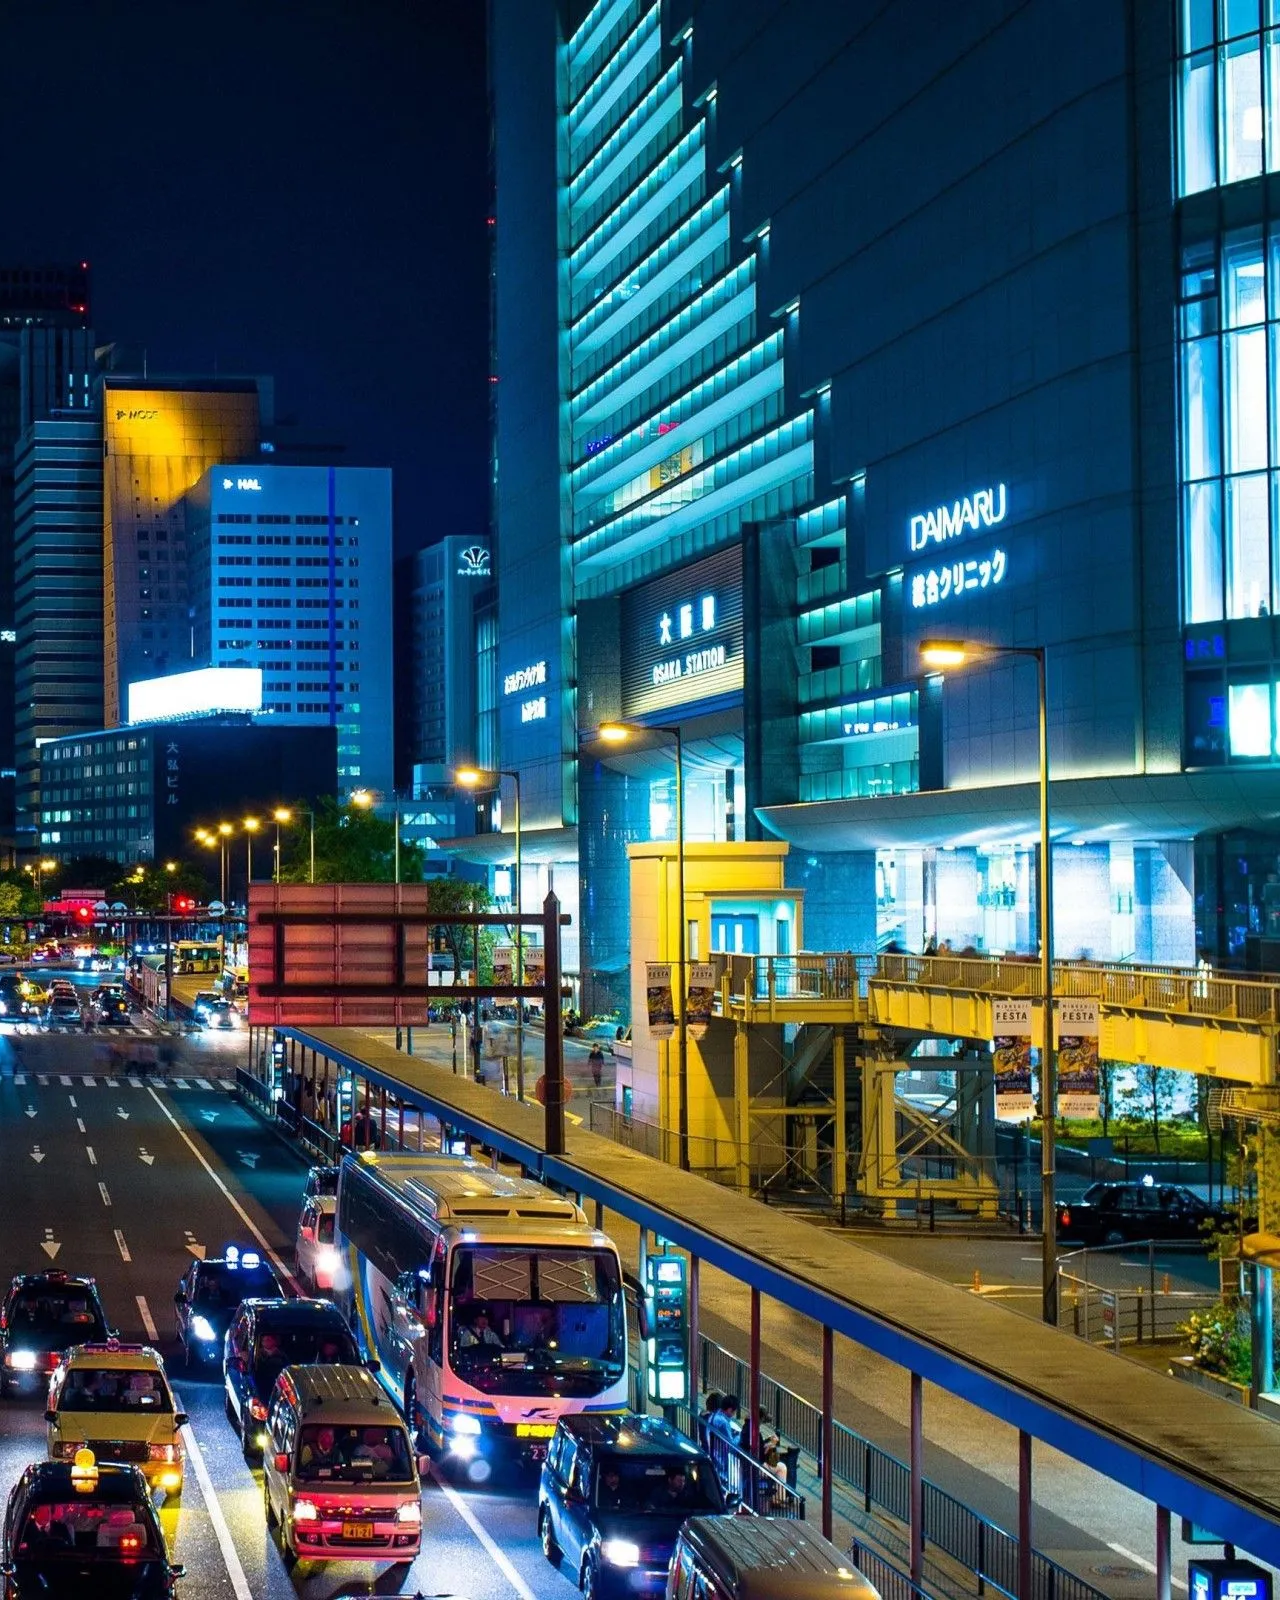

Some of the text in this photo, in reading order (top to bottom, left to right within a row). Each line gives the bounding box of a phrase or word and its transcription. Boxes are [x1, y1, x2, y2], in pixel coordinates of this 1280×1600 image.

[129, 410, 158, 420] MODE
[237, 479, 261, 490] HAL
[911, 483, 1006, 551] DAIMARU
[653, 645, 724, 684] OSAKA STATION
[996, 1012, 1027, 1020] FESTA
[1062, 1012, 1094, 1020] FESTA
